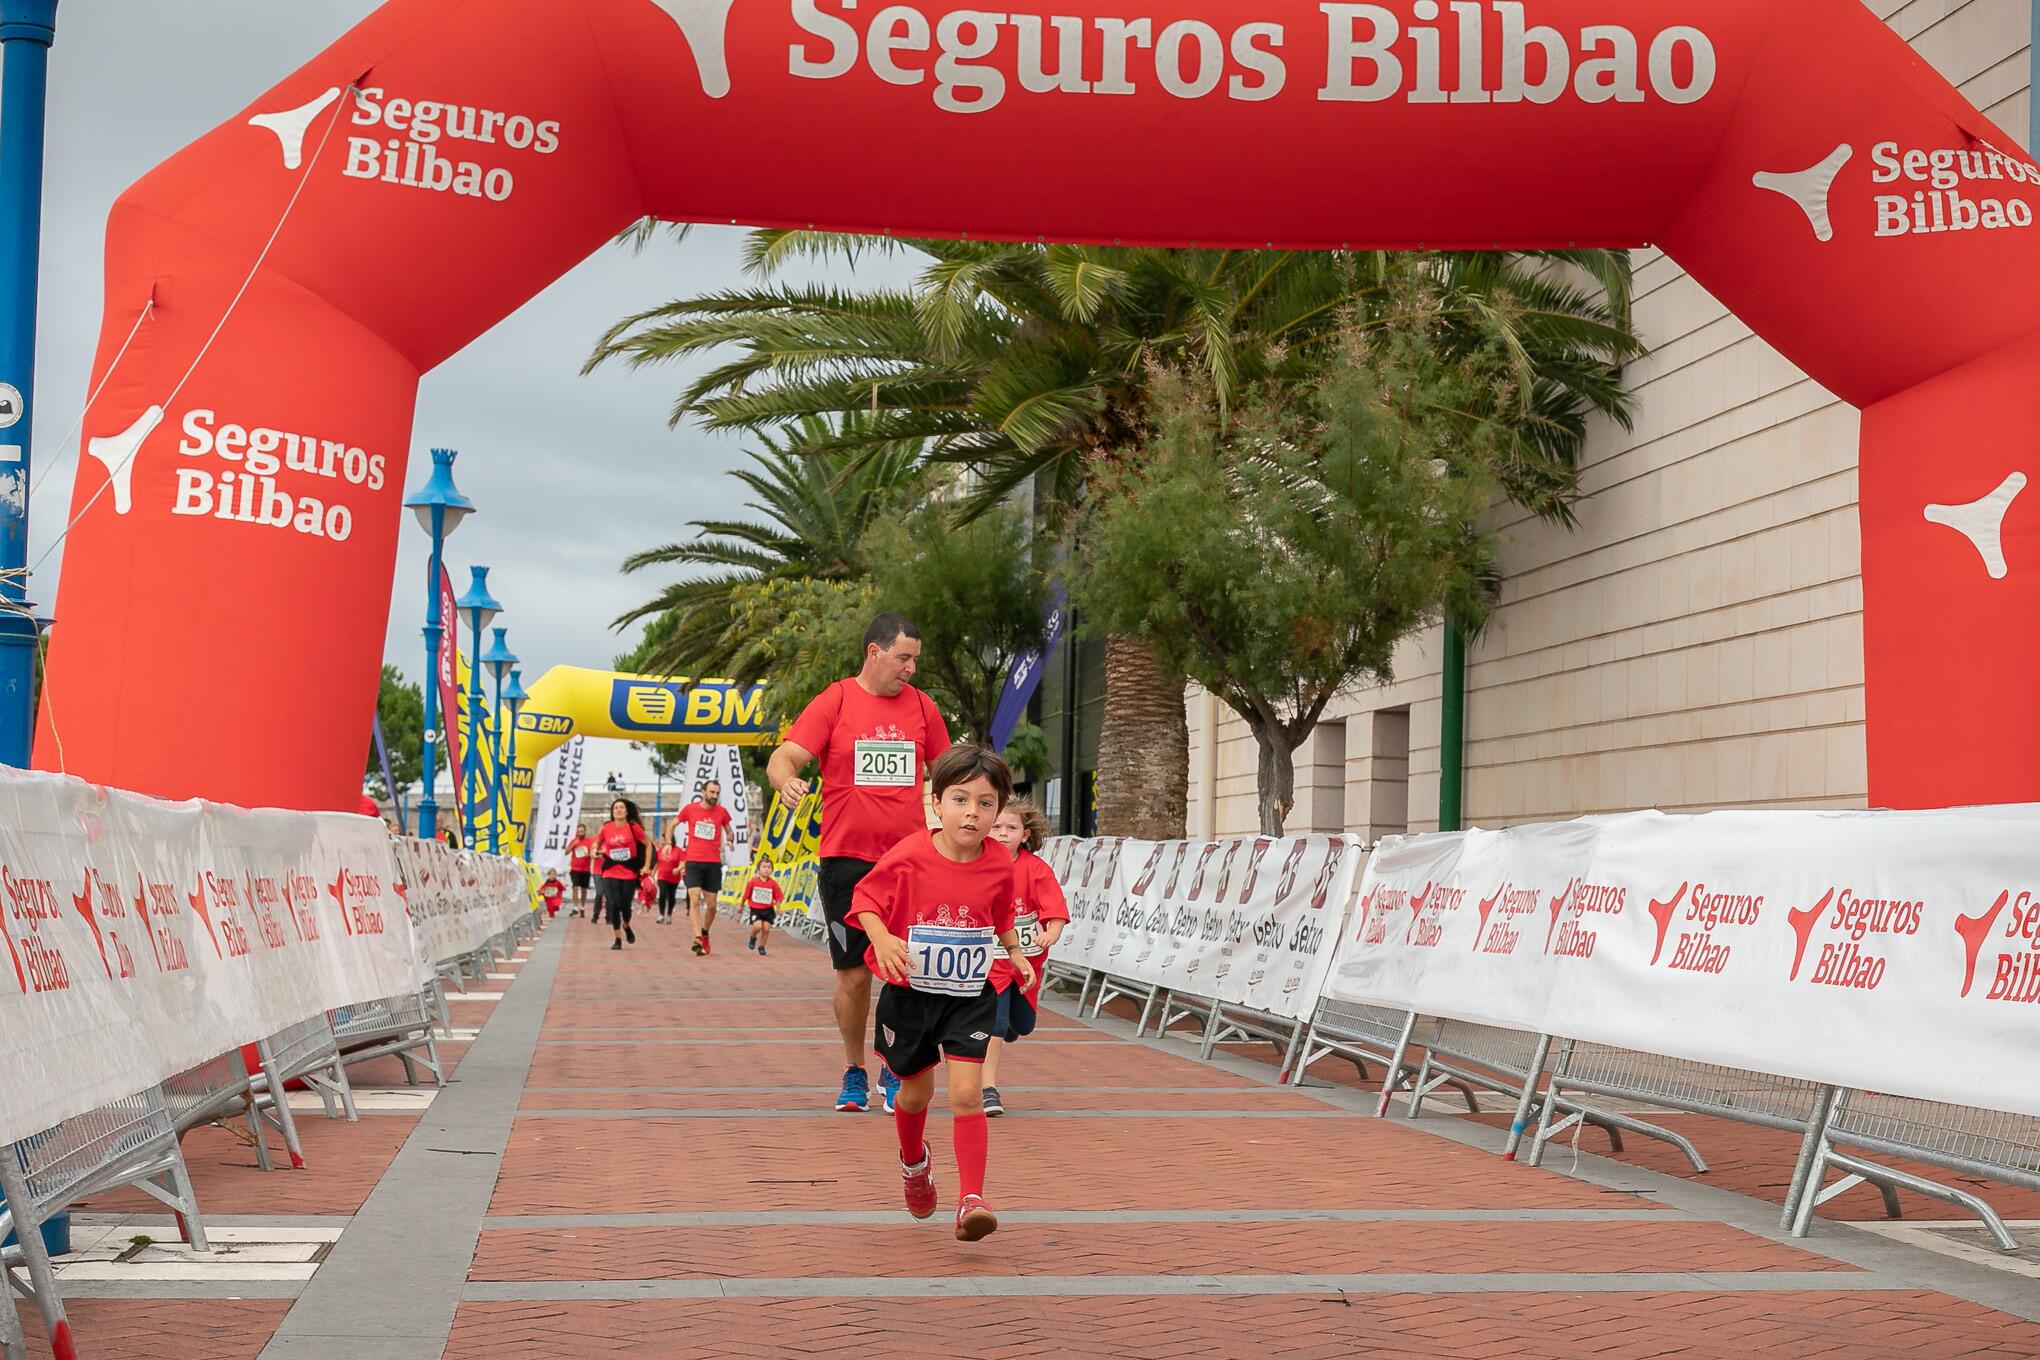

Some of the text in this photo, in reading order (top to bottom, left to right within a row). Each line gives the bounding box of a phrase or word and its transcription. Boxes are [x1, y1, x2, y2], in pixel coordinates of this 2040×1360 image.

[789, 0, 1717, 114] Seguros Bilbao
[351, 88, 561, 154] Seguros
[342, 136, 514, 202] Bilbao
[1871, 141, 2040, 190] Seguros
[1873, 190, 2033, 237] Bilbao
[178, 408, 386, 491] Seguros
[171, 467, 353, 542] Bilbao
[538, 717, 571, 733] BM
[684, 687, 764, 727] BM
[861, 752, 907, 775] 2051
[726, 744, 749, 844] EL CORR
[545, 824, 560, 850] EL
[344, 867, 382, 904] Seguros
[1498, 883, 1541, 921] Seguros
[1567, 877, 1627, 919] Seguros
[351, 905, 385, 935] Bilbao
[1116, 896, 1145, 930] Getxo
[1170, 904, 1198, 939] Getxo
[1686, 883, 1765, 932] Seguros
[1830, 888, 1924, 942] Seguros
[1252, 913, 1286, 950] Getxo
[1289, 914, 1324, 956] Getxo
[1482, 922, 1519, 955] Bilbao
[1553, 920, 1597, 959] Bilbao
[20, 934, 70, 993] Bilbao
[918, 945, 987, 980] 1002
[1668, 932, 1731, 974] Bilbao
[1810, 942, 1886, 990] Bilbao
